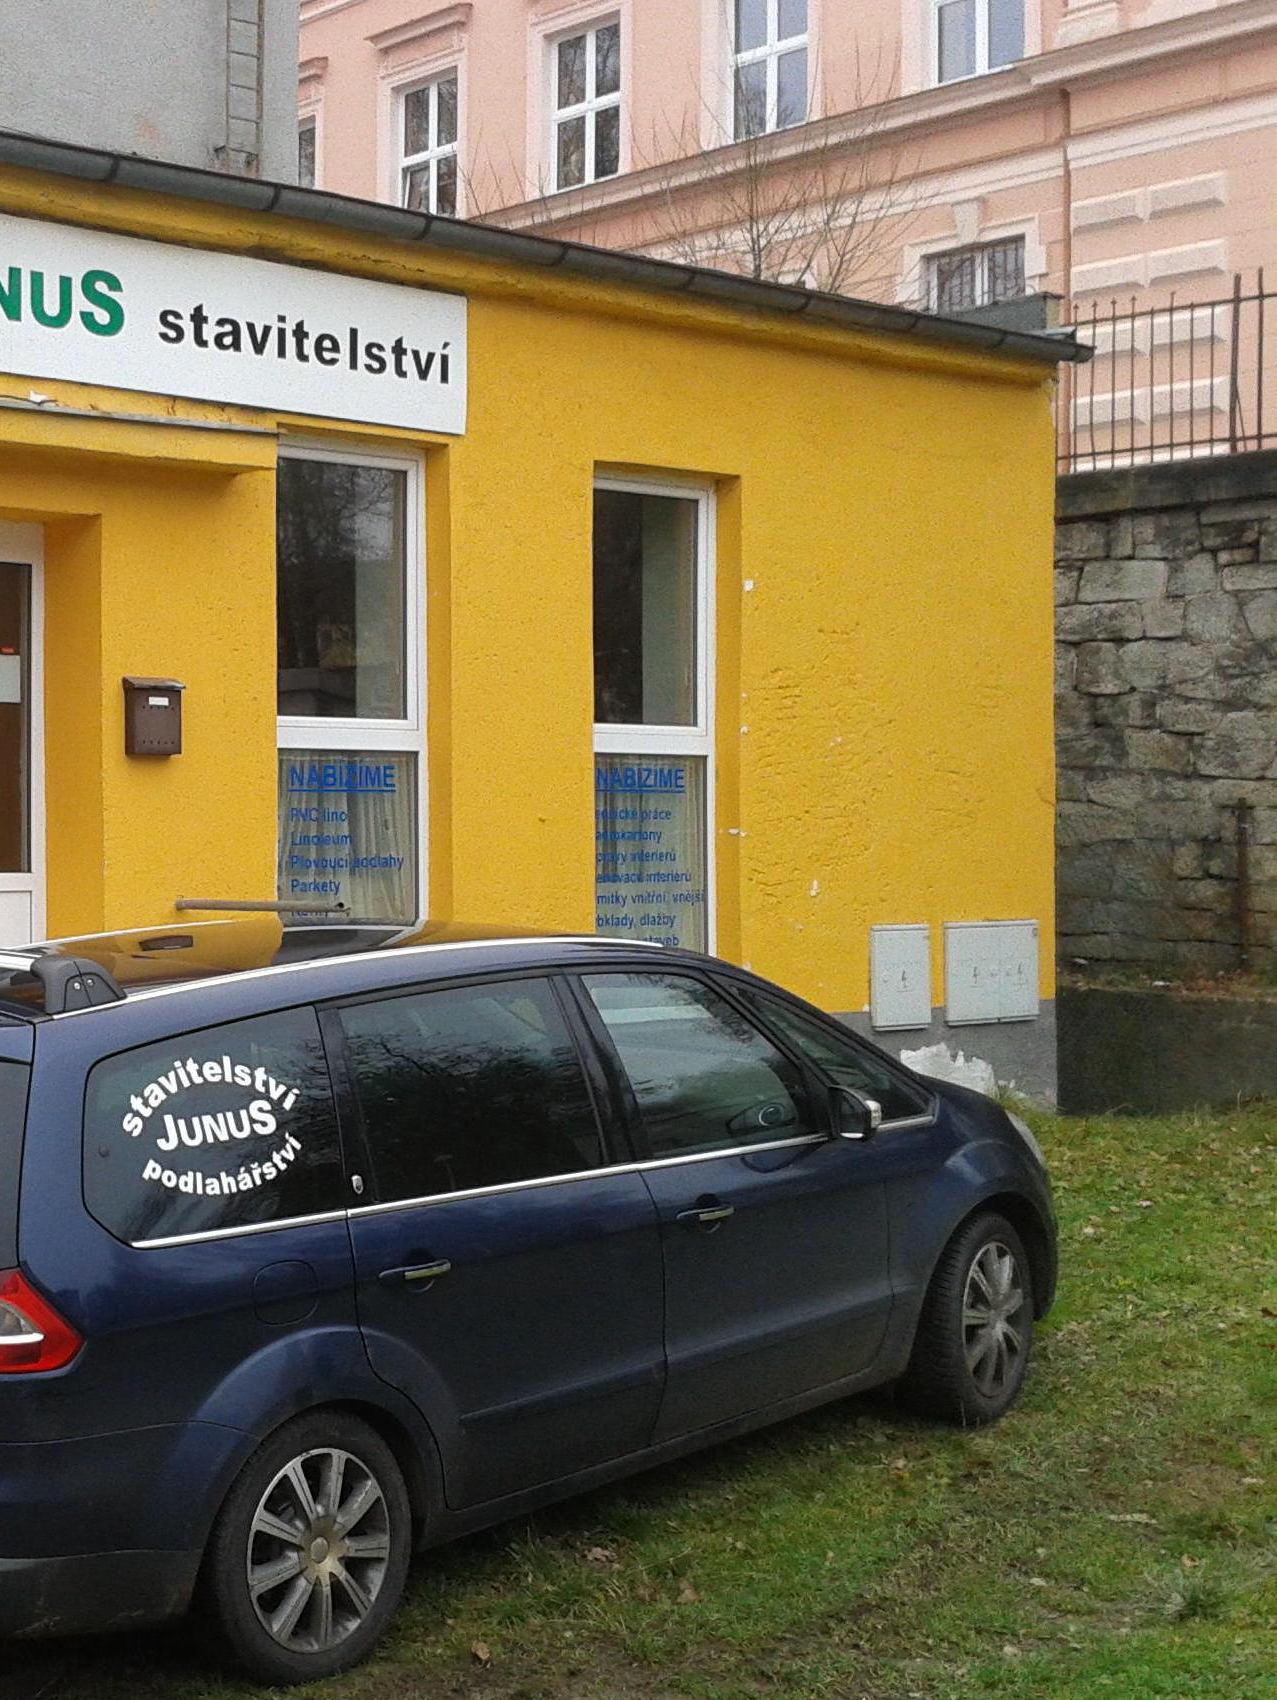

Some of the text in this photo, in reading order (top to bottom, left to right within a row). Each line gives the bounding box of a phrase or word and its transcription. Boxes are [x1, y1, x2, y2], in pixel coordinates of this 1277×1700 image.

[158, 304, 451, 384] stavitelství
[290, 807, 348, 822] PVC lino
[291, 832, 353, 846] Linoleum
[291, 878, 341, 896] Parkety
[122, 1055, 301, 1137] stavitelství
[156, 1099, 277, 1151] JUNUS
[142, 1131, 302, 1196] podlahářství
